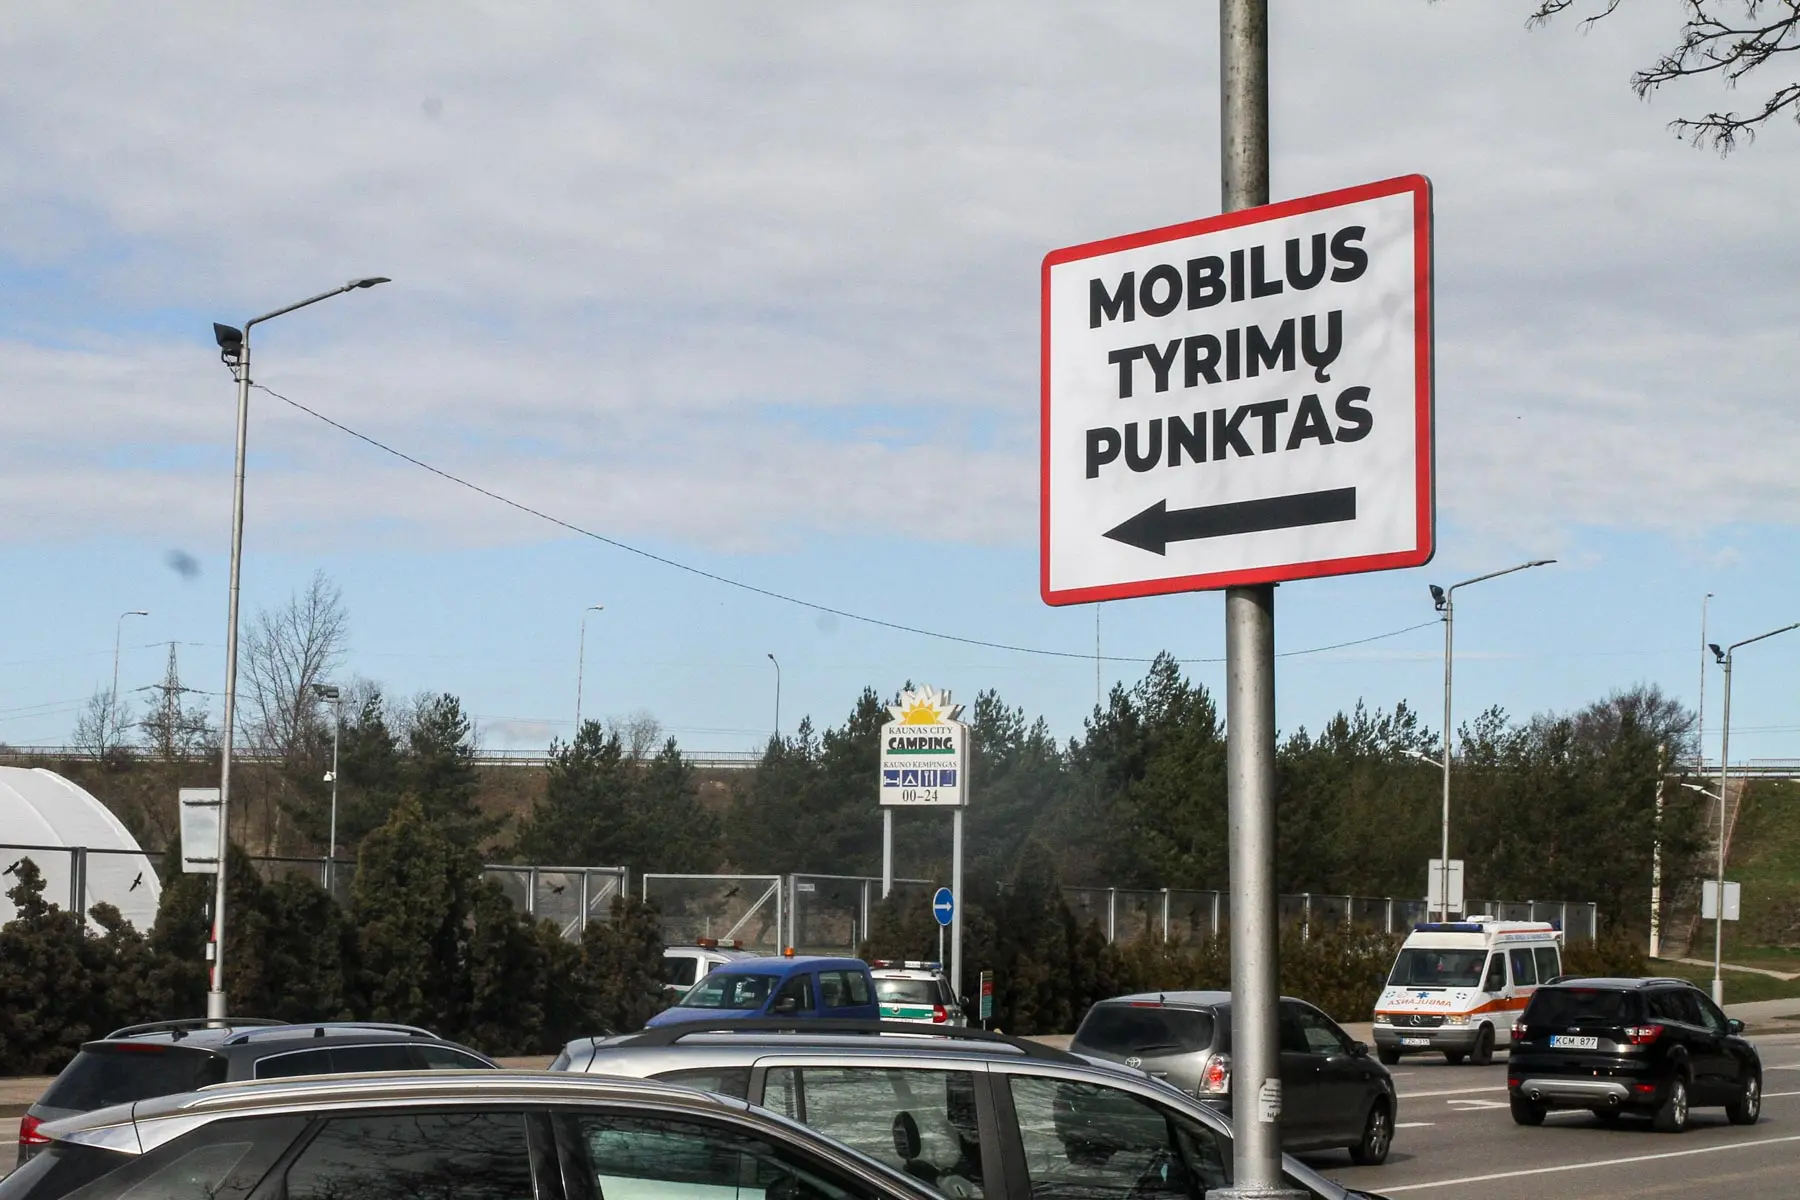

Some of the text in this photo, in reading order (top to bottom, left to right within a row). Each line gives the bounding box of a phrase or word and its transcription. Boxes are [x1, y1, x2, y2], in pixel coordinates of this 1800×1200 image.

[1089, 225, 1369, 329] MOBILUS
[1108, 310, 1343, 399] TYRIMŲ
[1086, 386, 1374, 479] PUNKTAS
[888, 737, 953, 749] CAMPING
[889, 727, 953, 735] KAUNAS CITY
[1555, 1037, 1596, 1046] KCM 877
